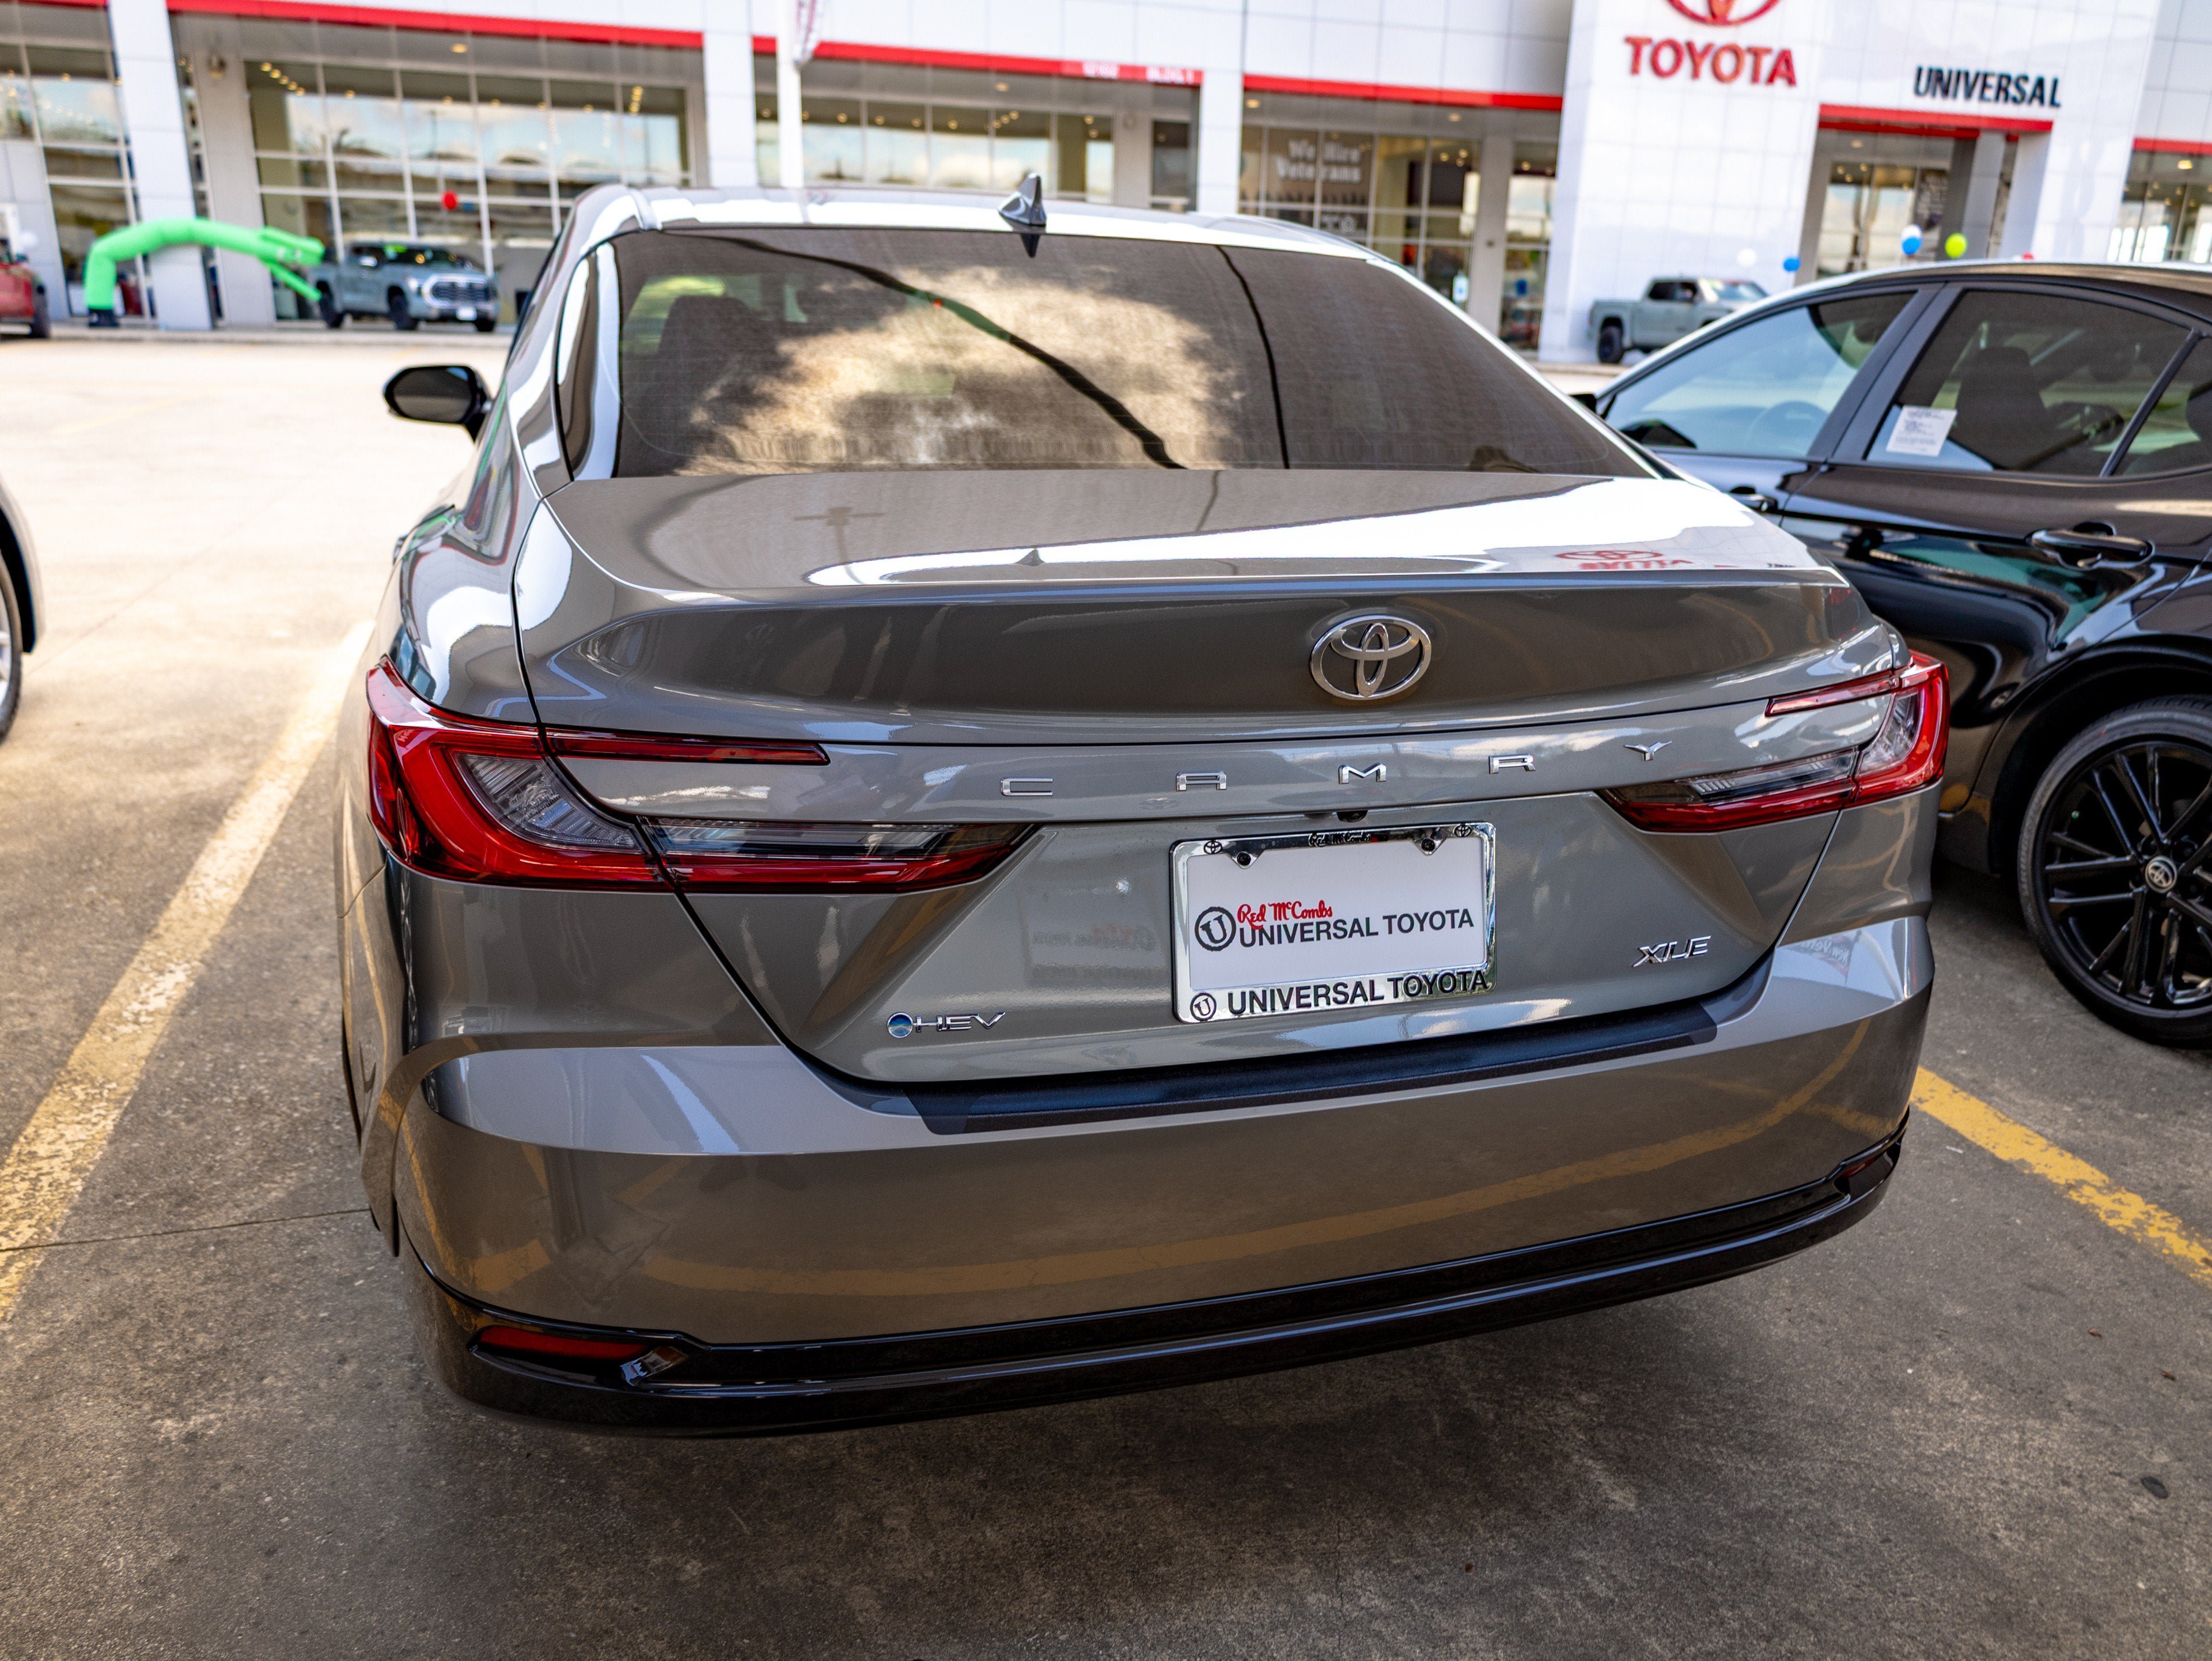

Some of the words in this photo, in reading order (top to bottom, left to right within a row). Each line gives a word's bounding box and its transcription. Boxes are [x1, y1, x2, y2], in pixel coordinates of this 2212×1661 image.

[1624, 35, 1797, 87] TOYOTA
[1914, 65, 2061, 108] UNIVERSAL
[1288, 140, 1316, 160] We
[1275, 156, 1361, 184] Veterans
[1000, 740, 1673, 797] CAMRY
[1237, 903, 1267, 930] Red
[1268, 900, 1332, 921] McCombs
[1240, 917, 1378, 948] UNIVERSAL
[1382, 908, 1475, 935] TOYOTA
[1631, 935, 1711, 967] XLE
[1228, 979, 1385, 1015] UNIVERSAL
[1387, 970, 1488, 999] TOYOTA
[916, 1012, 1006, 1033] HEV
